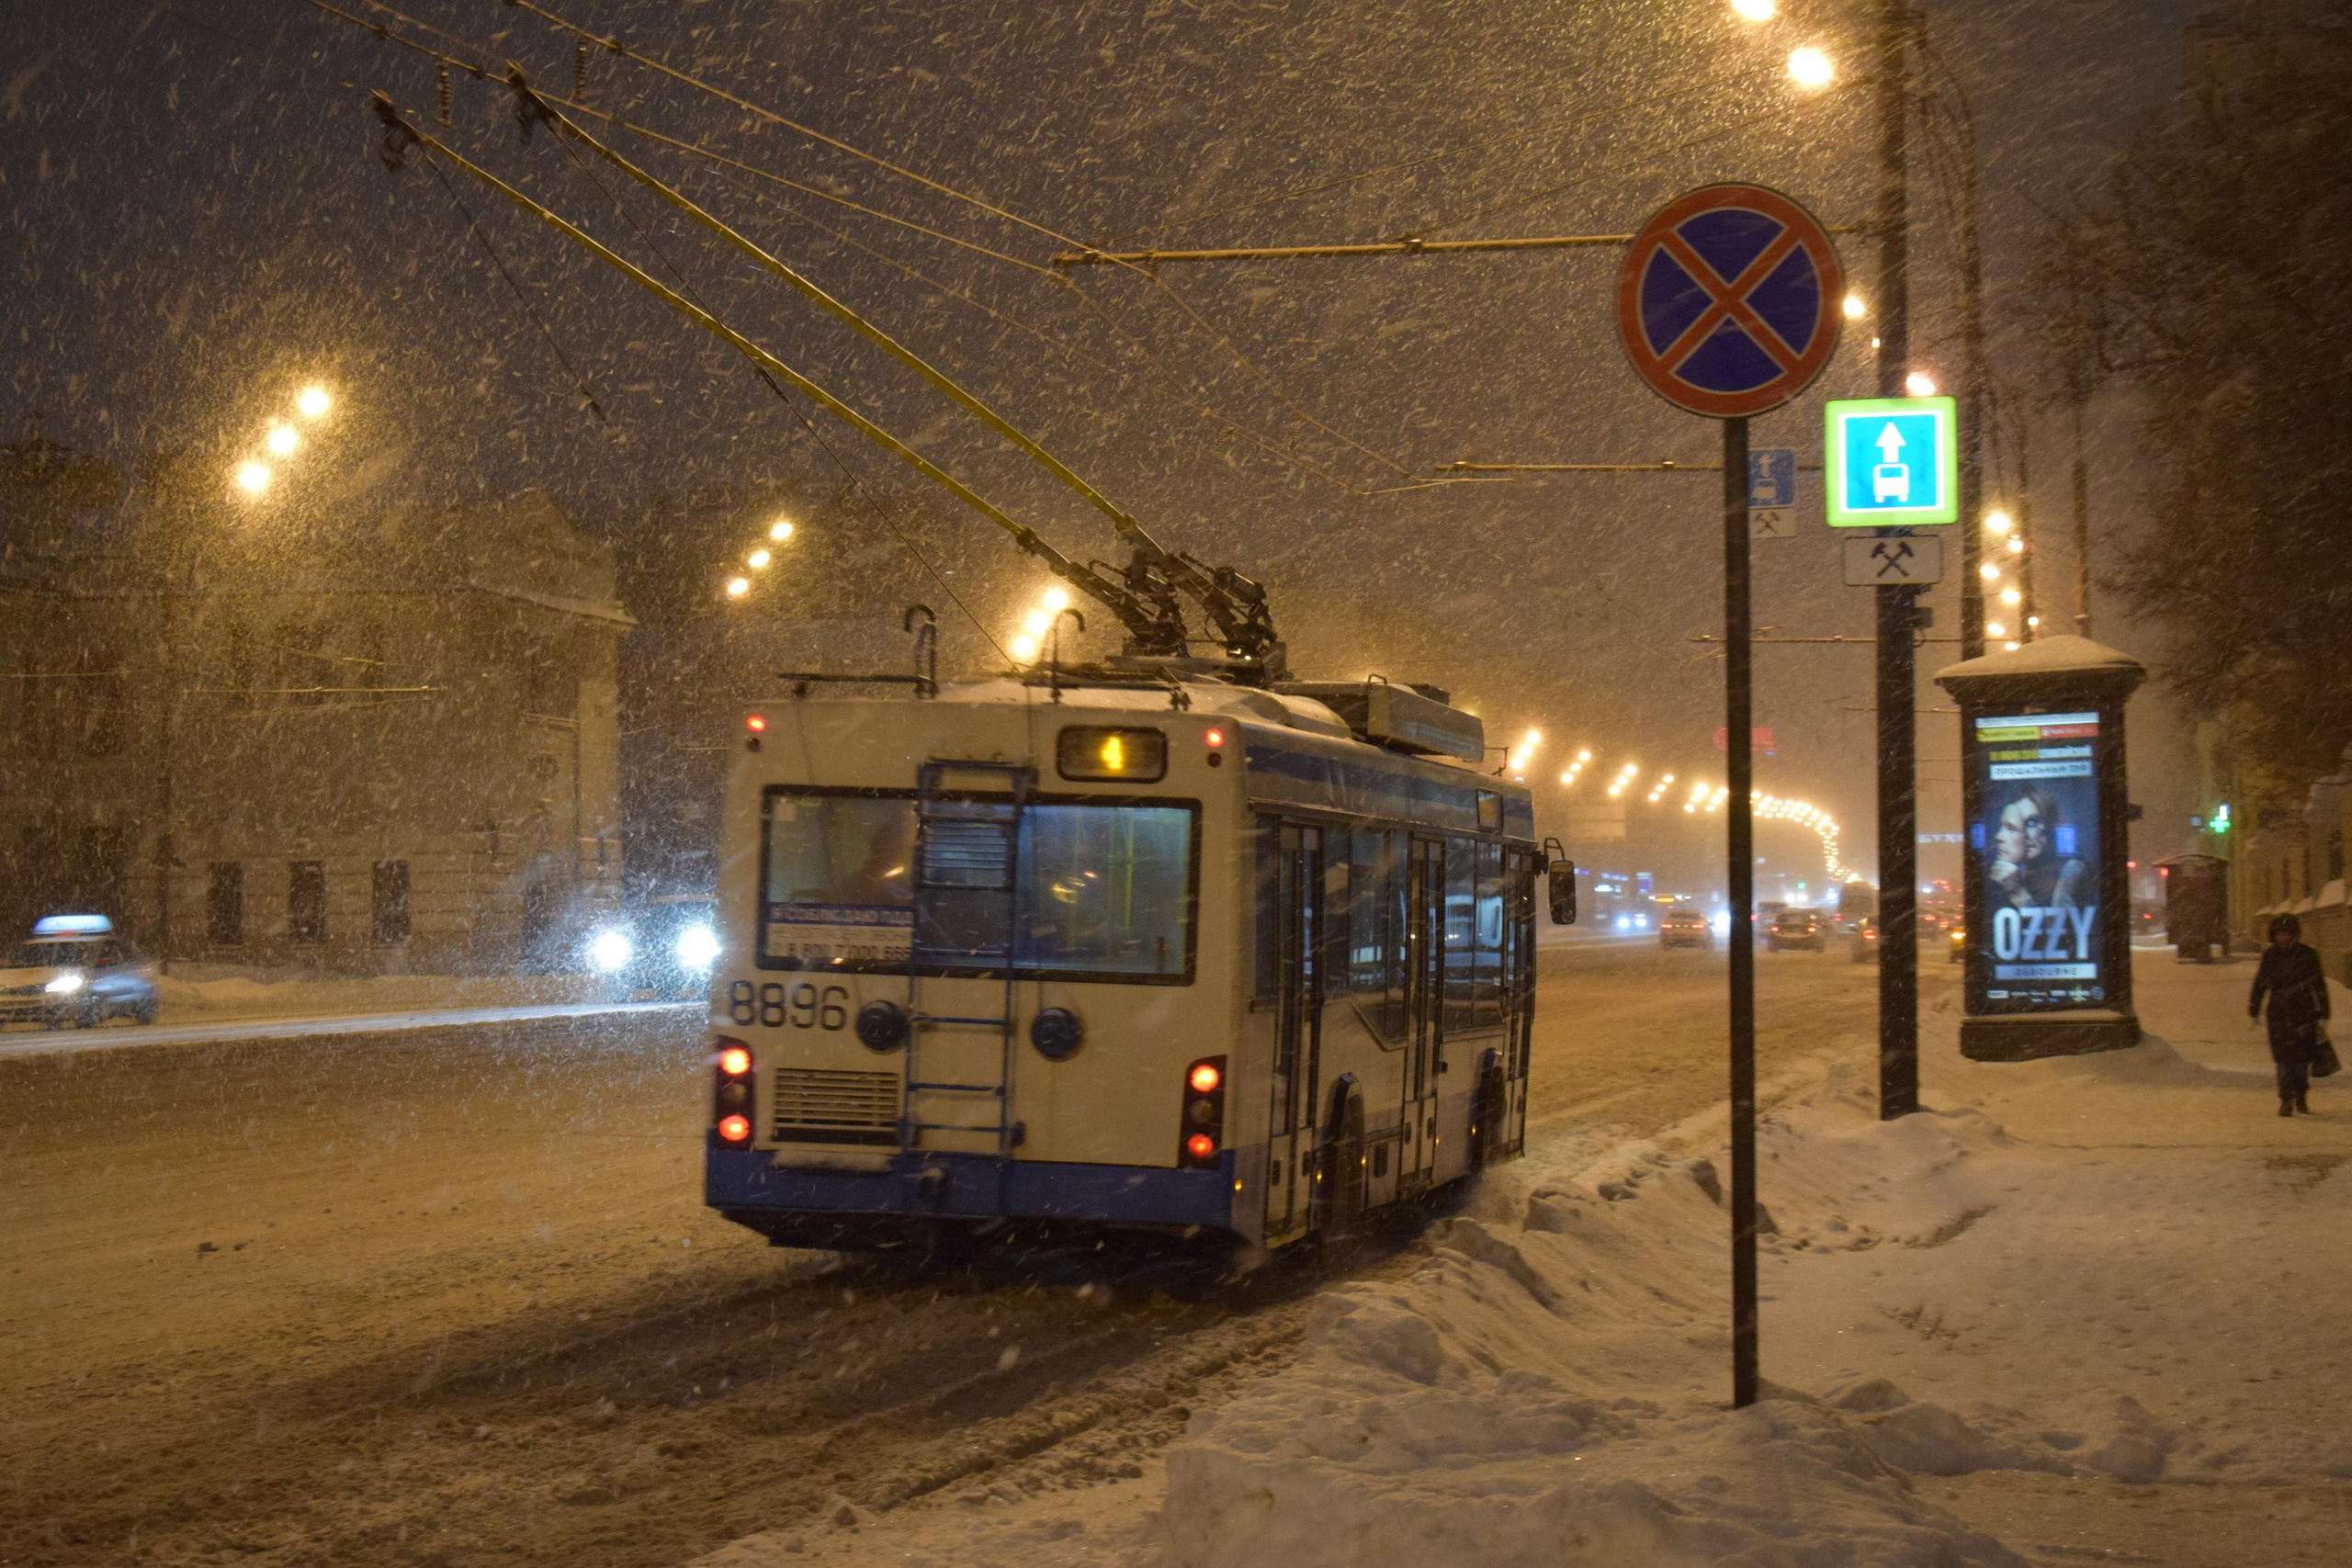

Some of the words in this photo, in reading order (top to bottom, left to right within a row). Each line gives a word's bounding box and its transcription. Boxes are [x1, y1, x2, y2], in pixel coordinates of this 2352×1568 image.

[1102, 736, 1123, 770] 4
[1993, 905, 2096, 961] OZZY
[730, 980, 847, 1031] 8896
